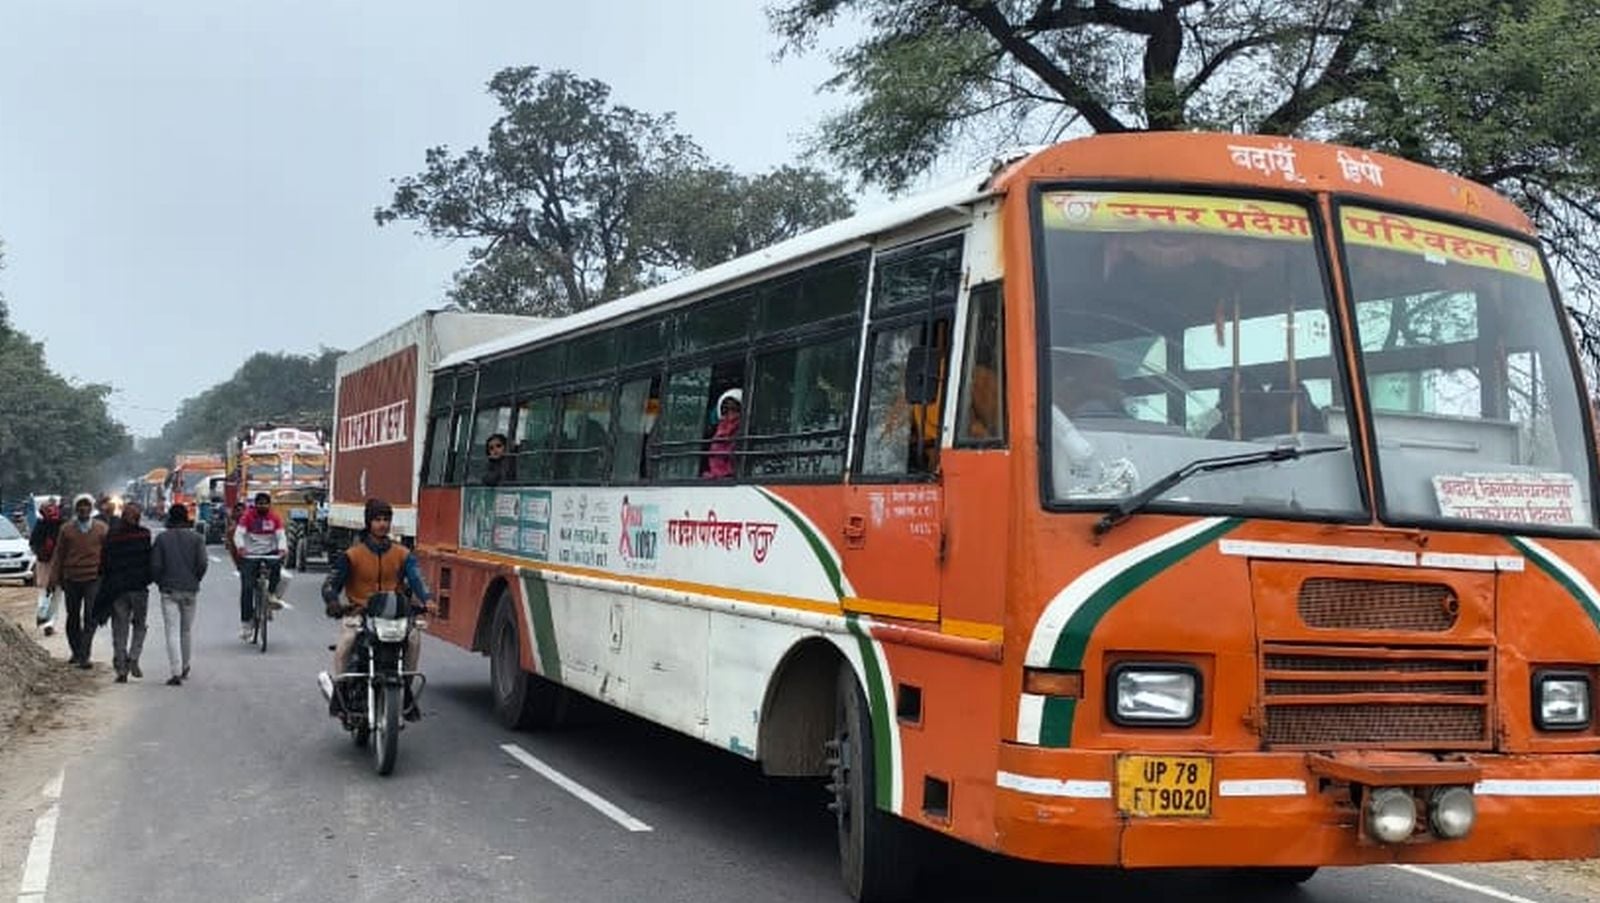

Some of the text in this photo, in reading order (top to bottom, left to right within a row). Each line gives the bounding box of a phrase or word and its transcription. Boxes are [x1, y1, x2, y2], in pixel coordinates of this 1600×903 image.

[1214, 205, 1309, 236] प्रदेश
[1345, 215, 1501, 266] परिवहन
[1143, 761, 1198, 784] UP 78
[1133, 787, 1207, 811] FT9020
